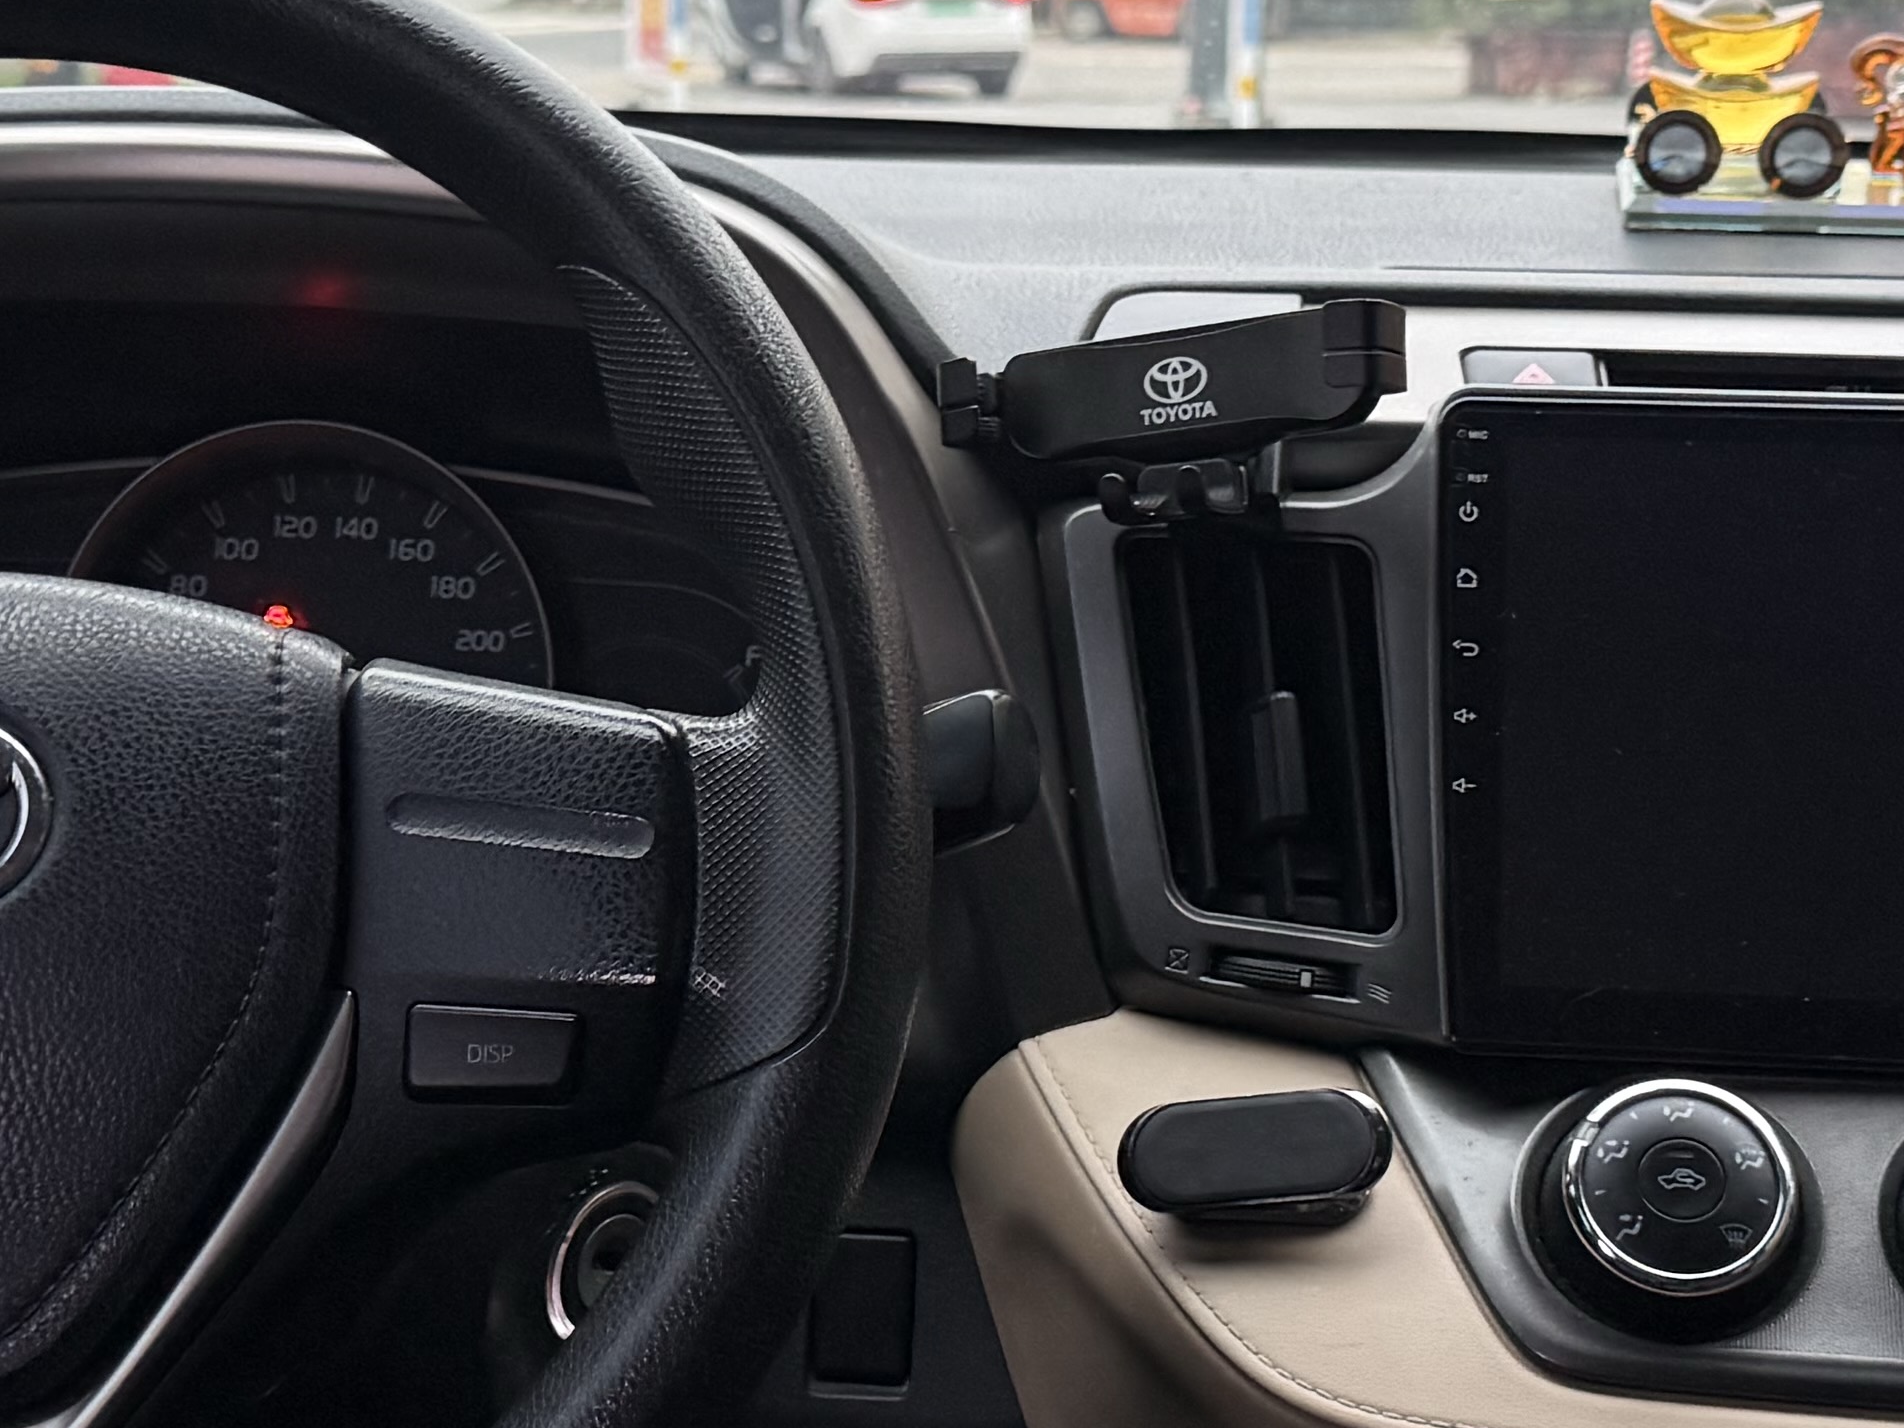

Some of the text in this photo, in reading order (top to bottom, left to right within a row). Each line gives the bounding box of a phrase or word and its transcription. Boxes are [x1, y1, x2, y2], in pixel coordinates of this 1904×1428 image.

[1140, 401, 1217, 426] TOYOTA
[273, 515, 317, 539] 120
[334, 516, 378, 541] 140
[214, 536, 260, 562] 100
[388, 537, 435, 563] 160
[167, 574, 208, 598] 80
[430, 575, 475, 601] 180
[454, 629, 507, 654] 200
[745, 644, 765, 667] F
[466, 1043, 515, 1064] DISP
